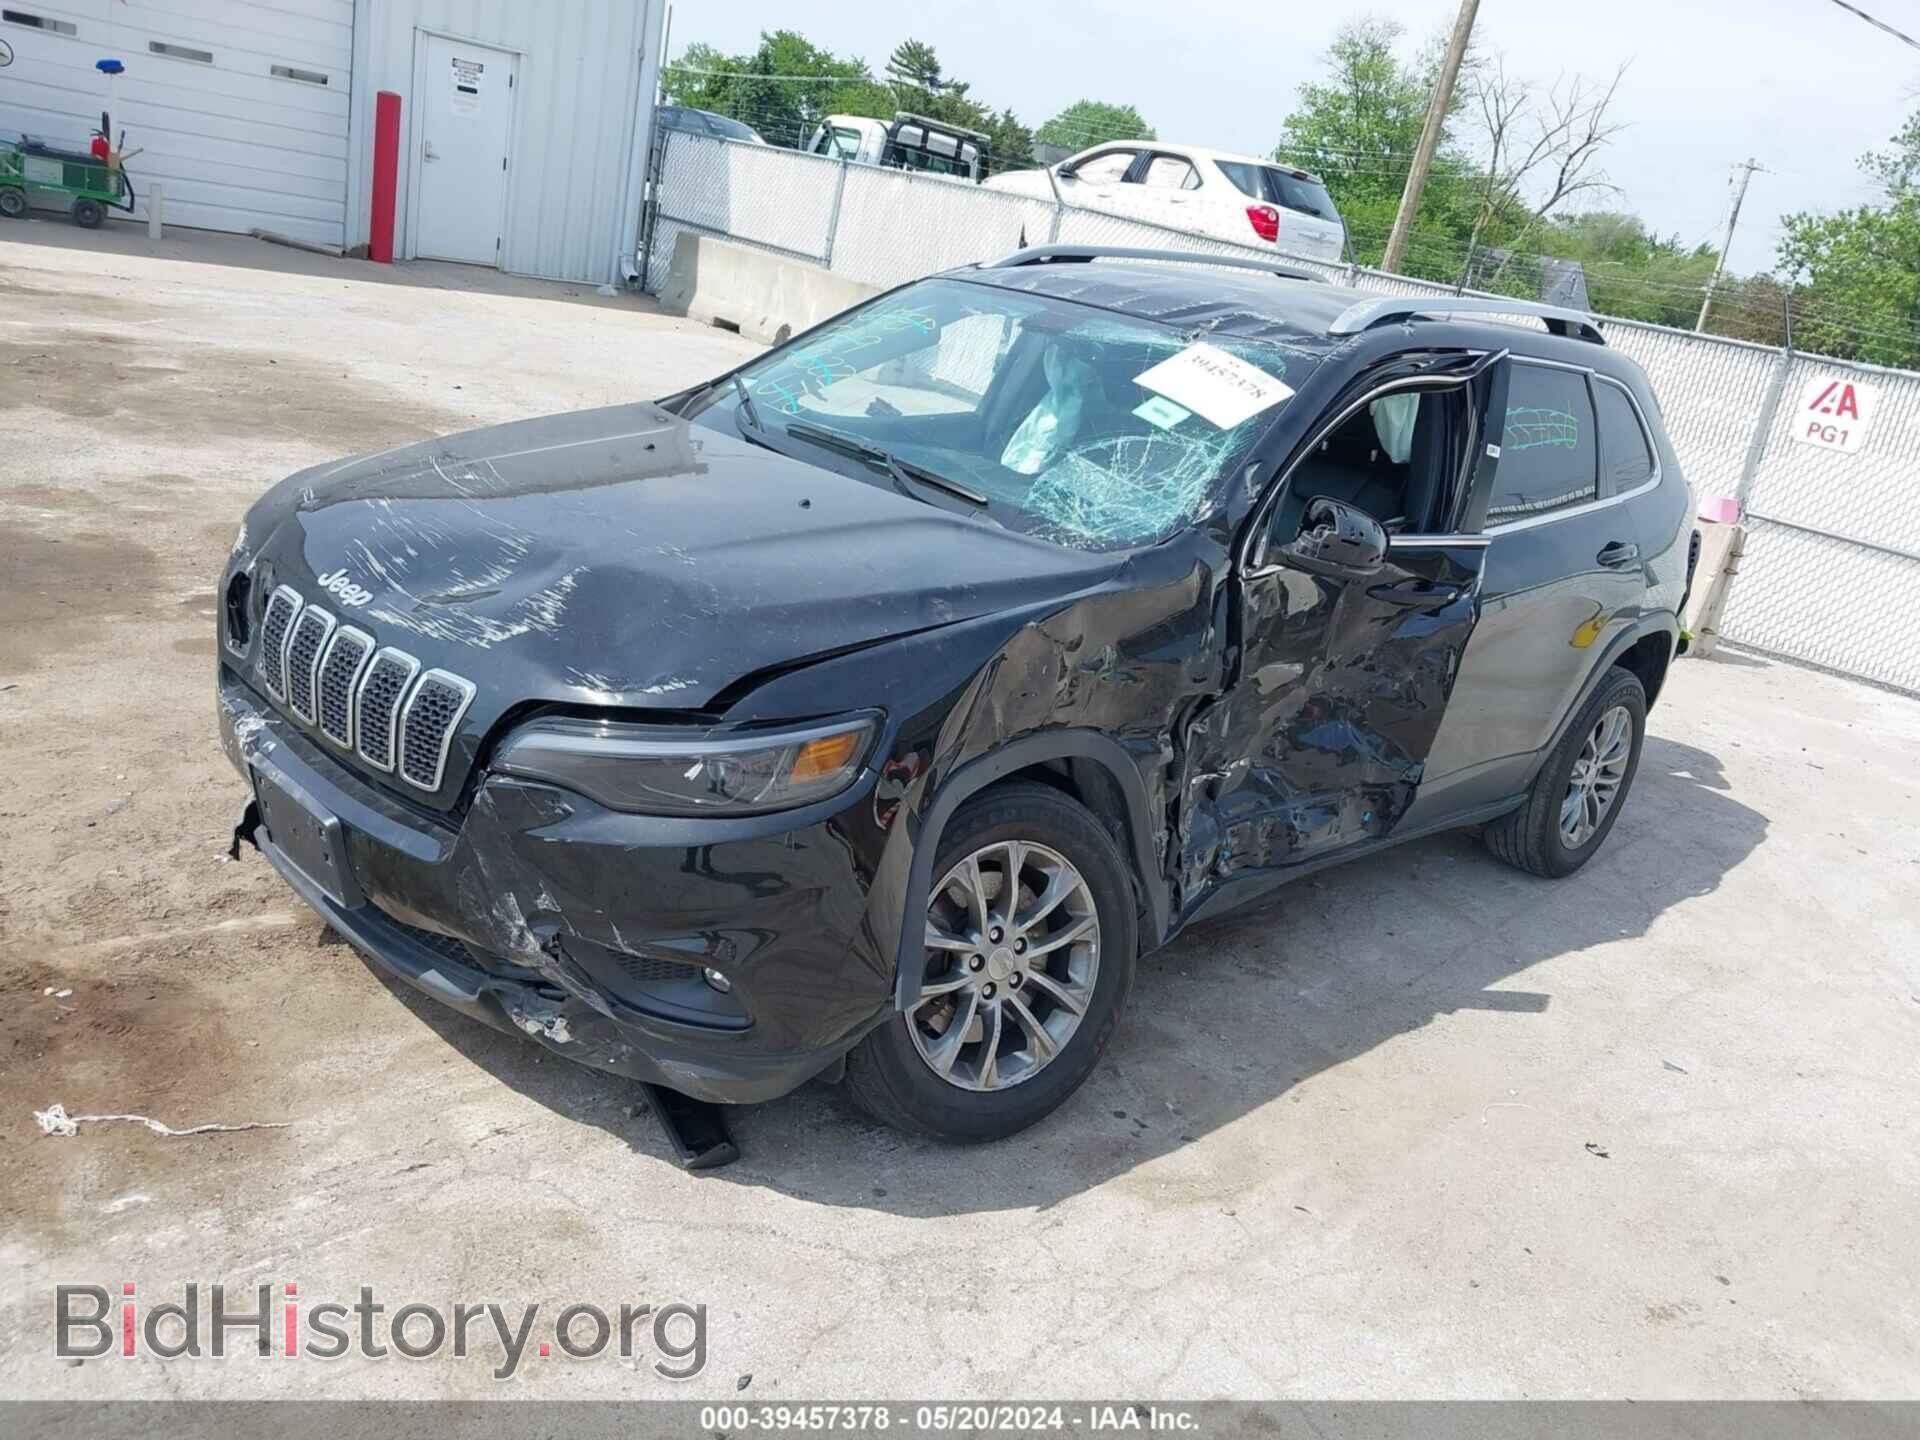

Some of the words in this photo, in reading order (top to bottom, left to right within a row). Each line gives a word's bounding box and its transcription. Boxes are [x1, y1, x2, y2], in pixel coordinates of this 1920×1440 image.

[1808, 381, 1858, 420] AA
[1807, 421, 1849, 446] PG1
[317, 568, 374, 606] Jeep
